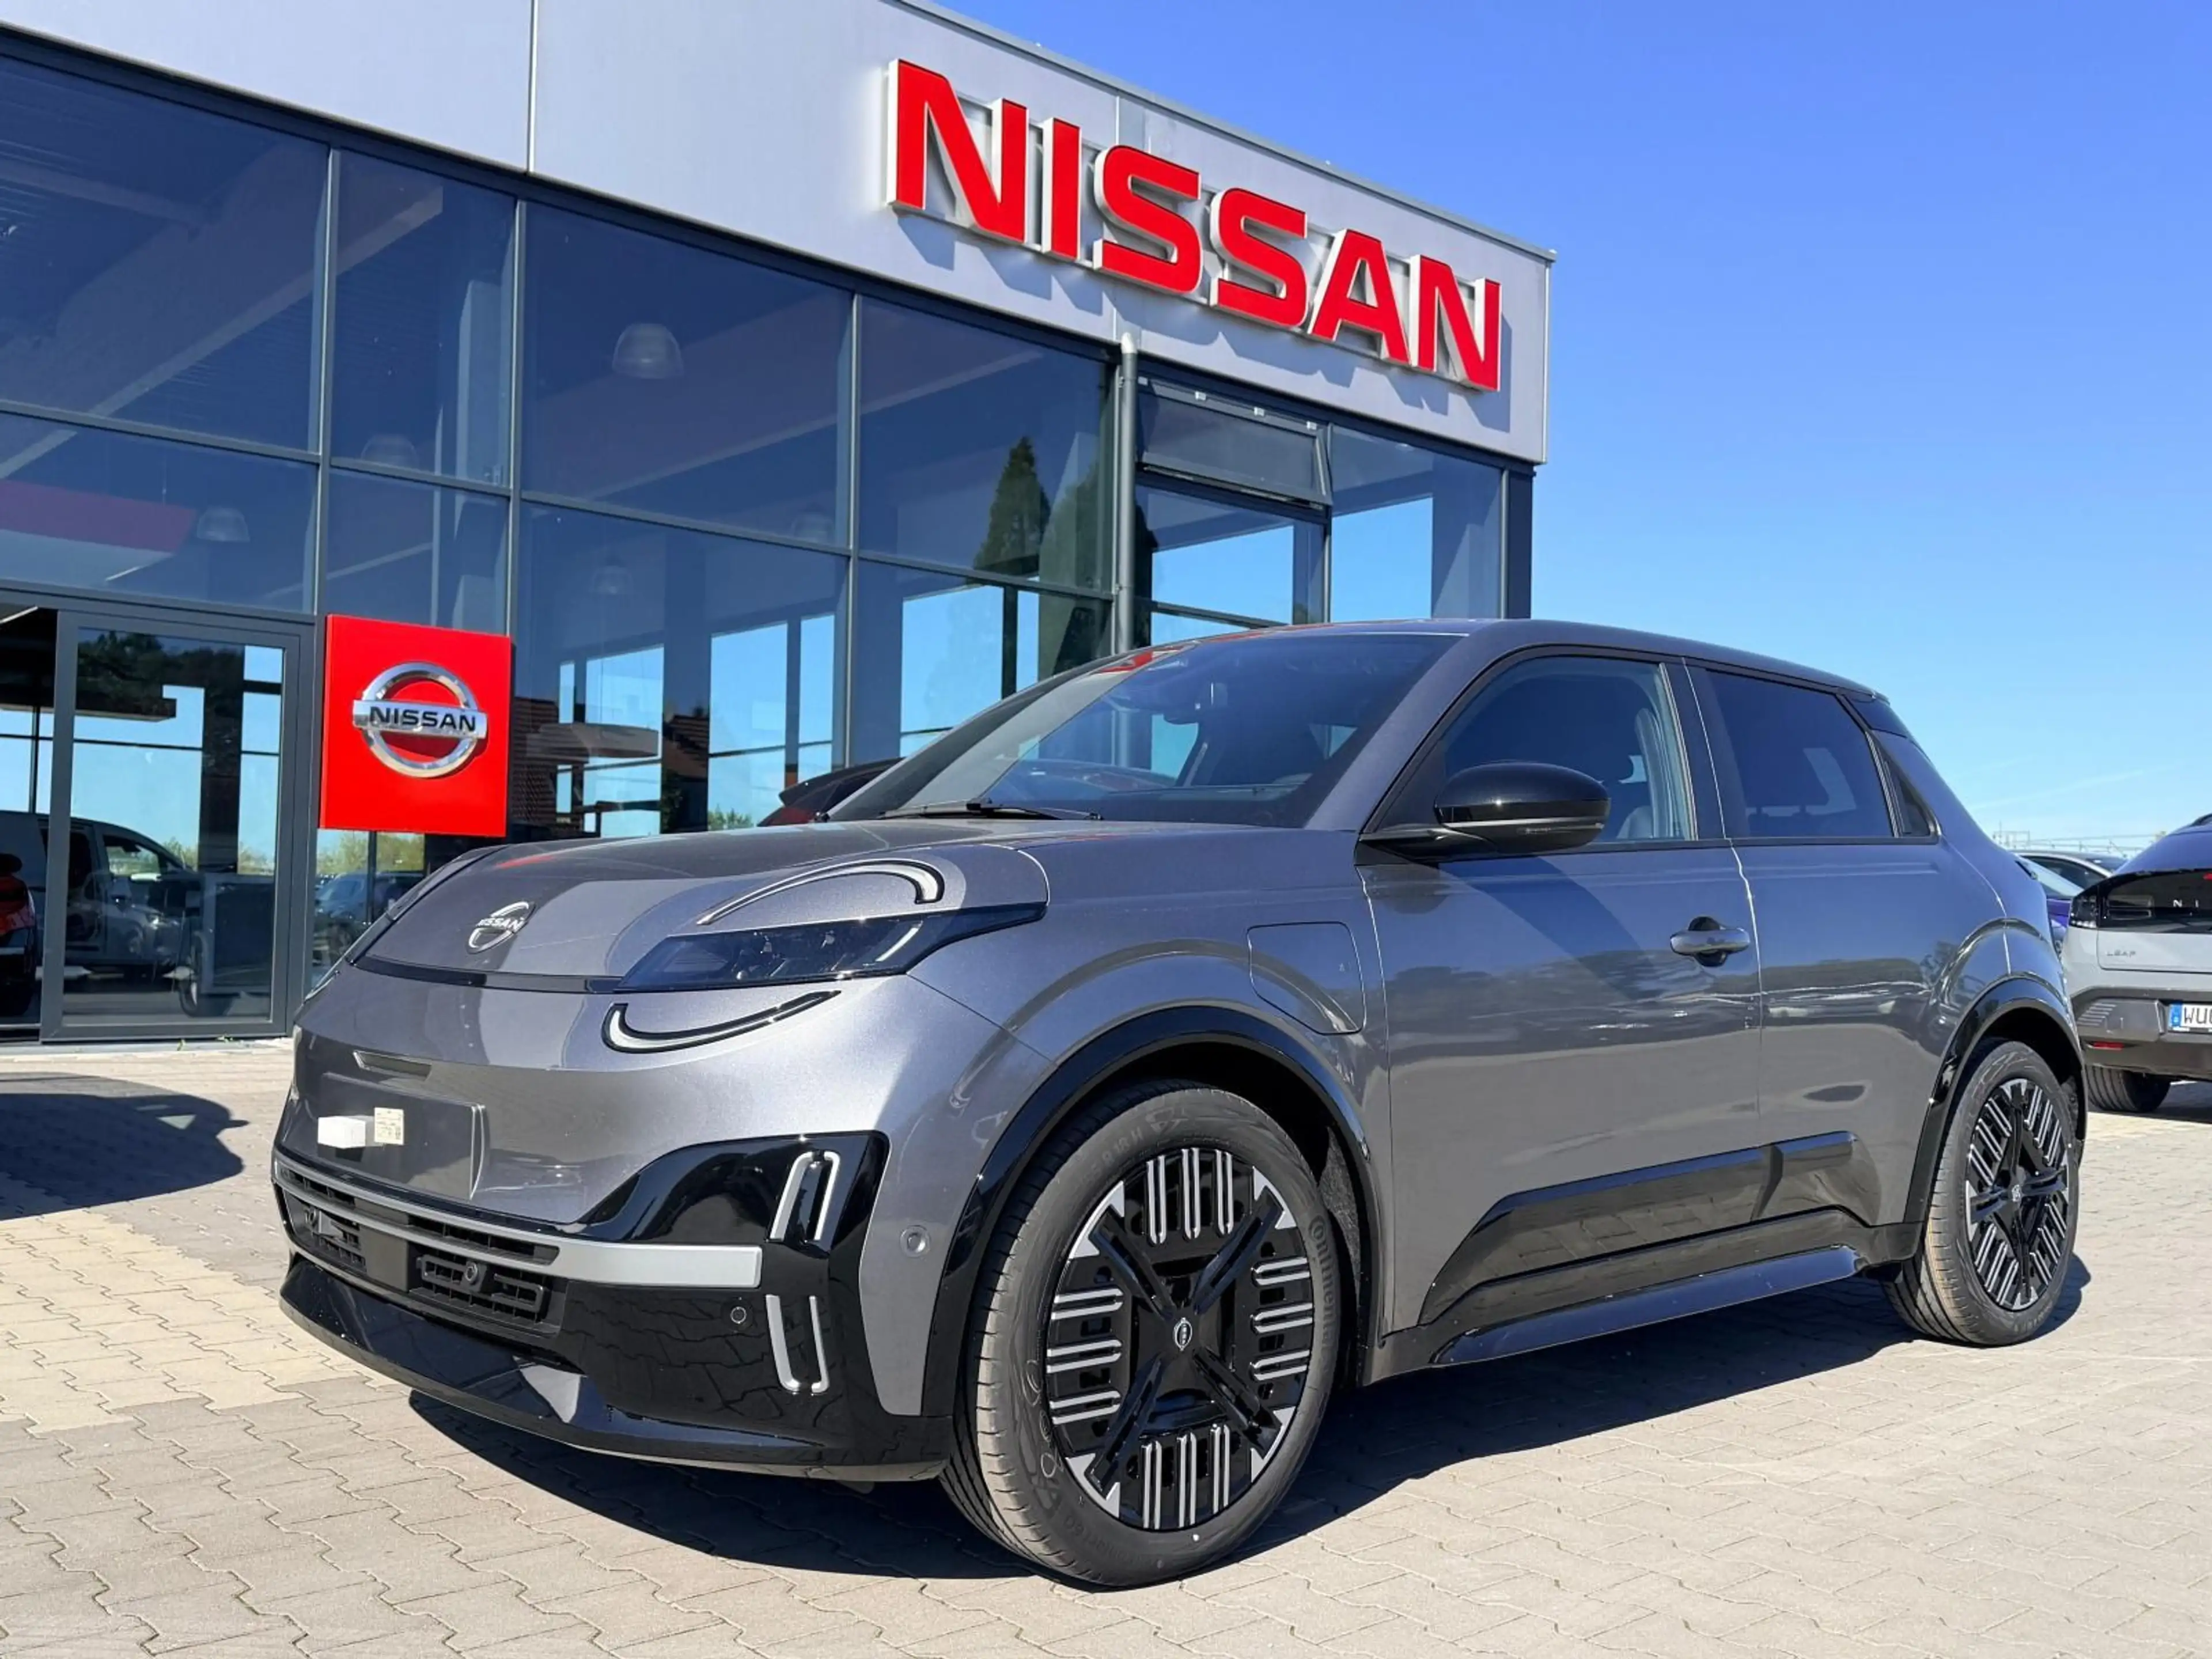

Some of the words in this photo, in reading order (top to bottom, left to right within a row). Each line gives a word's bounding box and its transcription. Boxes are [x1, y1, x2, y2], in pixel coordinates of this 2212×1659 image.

[888, 59, 1501, 392] NISSAN
[369, 706, 476, 732] NISSAN
[2184, 1006, 2212, 1024] WU
